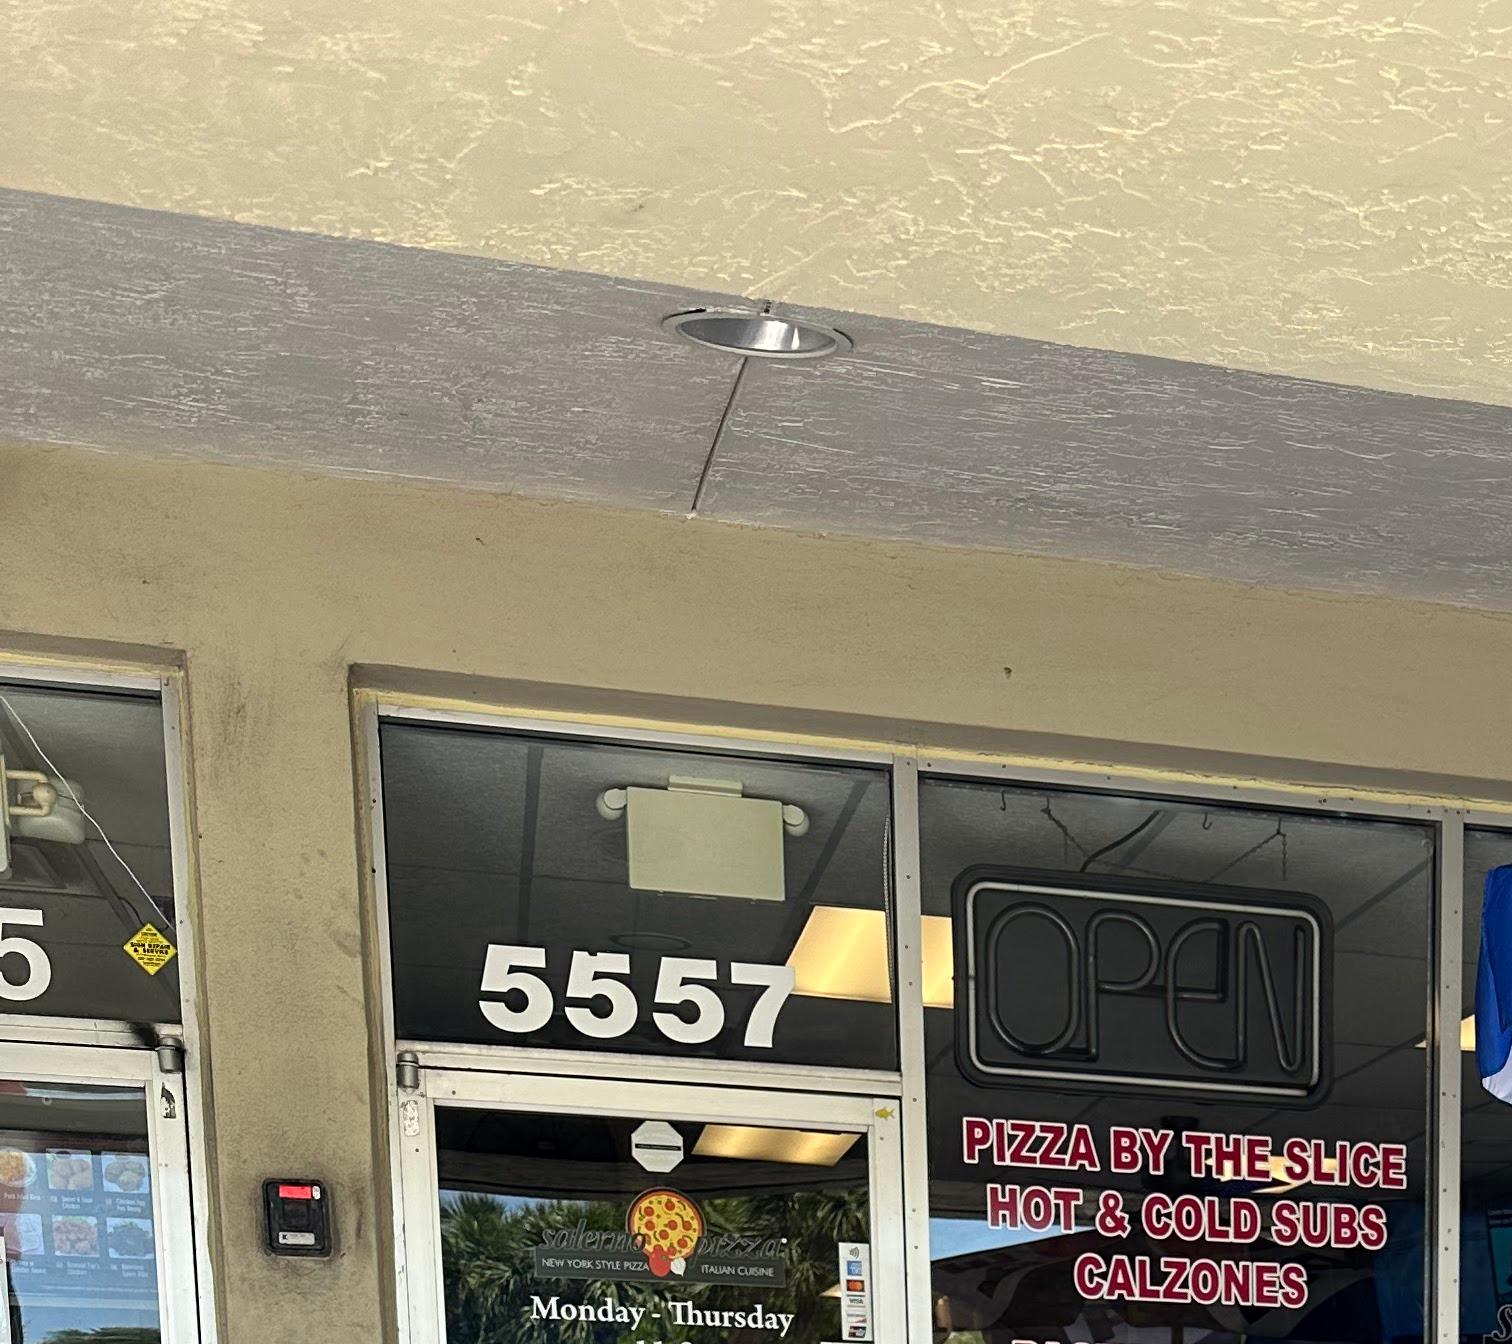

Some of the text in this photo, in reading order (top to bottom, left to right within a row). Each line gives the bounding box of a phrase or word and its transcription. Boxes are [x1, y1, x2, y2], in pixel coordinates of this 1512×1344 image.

[479, 943, 796, 1049] 5557
[986, 902, 1305, 1073] OPEN
[962, 1117, 1408, 1189] PIZZA BY THE SLICE
[986, 1185, 1387, 1249] HOT & COLD SUBS
[542, 1257, 775, 1277] NEW YORK STYLE PIZZA ITALIAN CUISINE
[1074, 1253, 1308, 1308] CALZONES
[529, 1295, 646, 1331] Monday
[667, 1300, 795, 1338] Thursday
